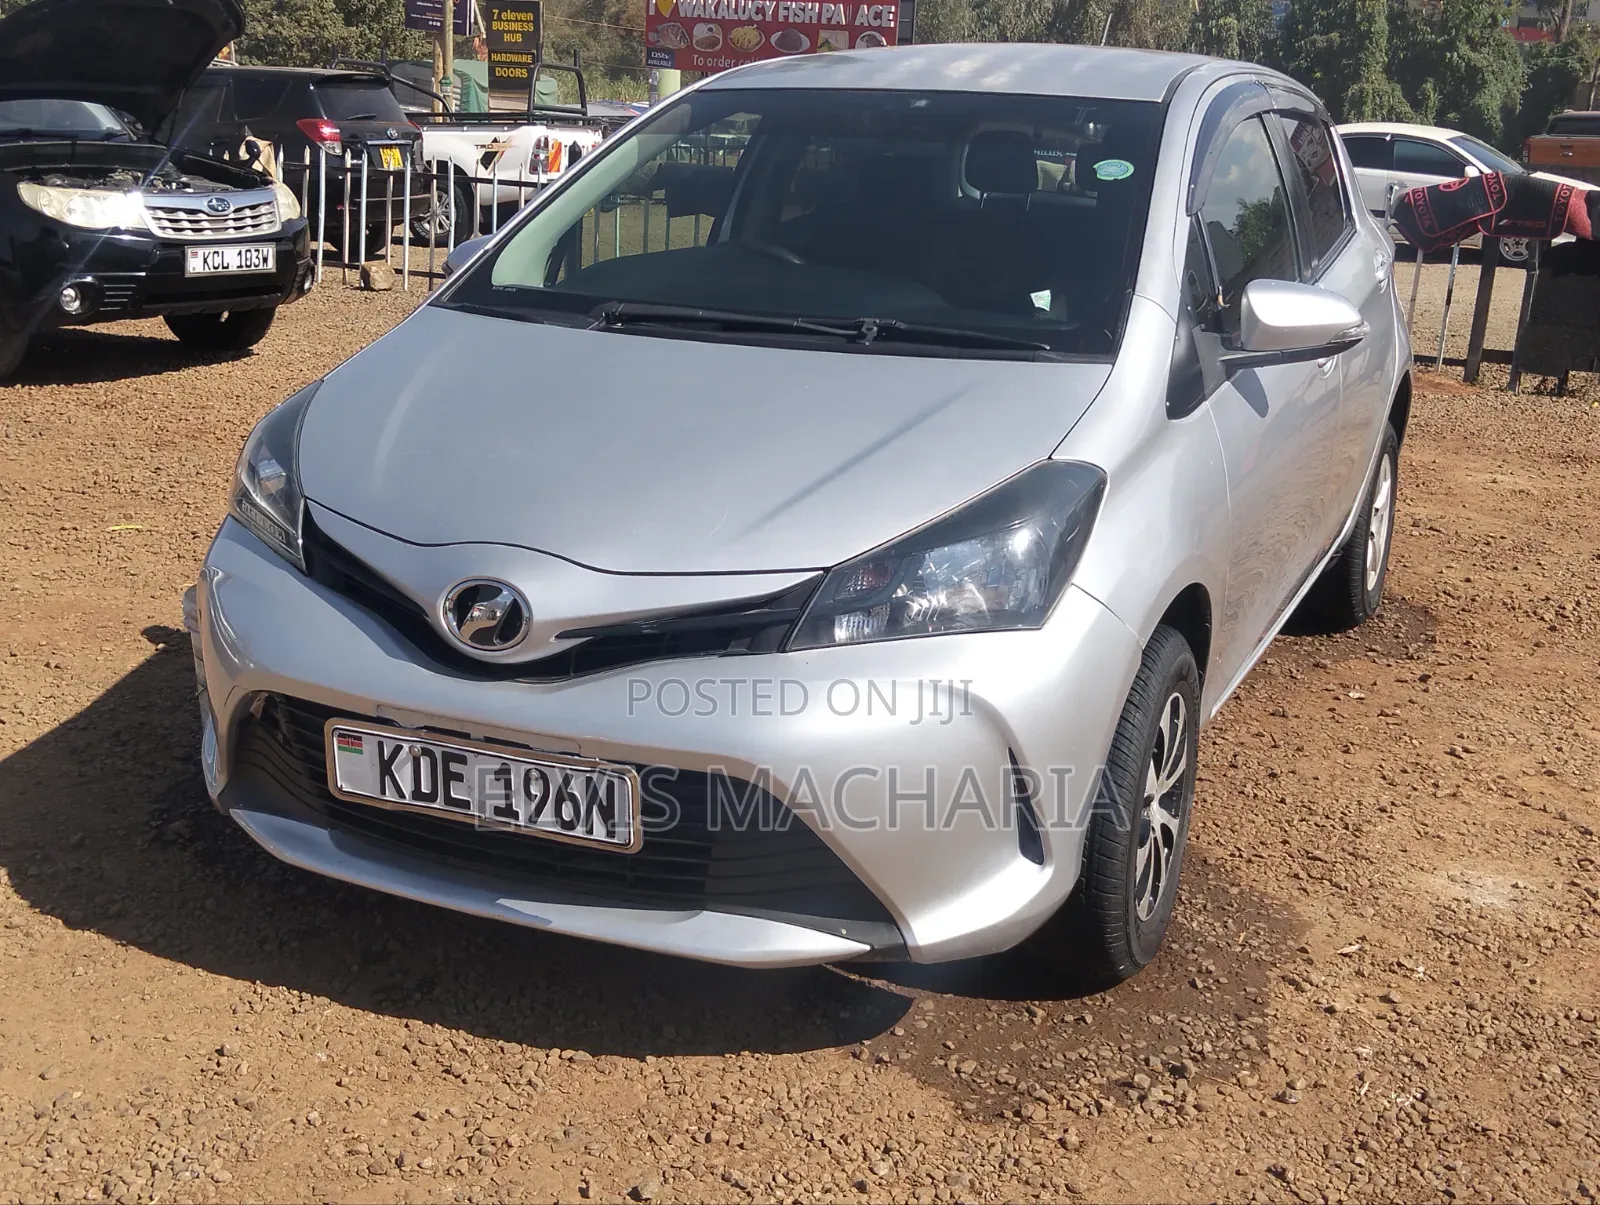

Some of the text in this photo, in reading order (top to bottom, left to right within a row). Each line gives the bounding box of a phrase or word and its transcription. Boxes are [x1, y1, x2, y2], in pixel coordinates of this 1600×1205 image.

[492, 9, 534, 21] 7 eleven
[677, 0, 777, 22] WAKALUCY
[778, 1, 819, 24] FISH
[821, 3, 895, 27] PAACE
[492, 21, 534, 31] BUSINESS
[503, 33, 523, 42] HUB
[491, 53, 533, 63] HARDWARE
[693, 54, 704, 66] To
[707, 55, 736, 68] order
[495, 67, 528, 77] DOORS
[203, 251, 230, 271] KCL
[377, 740, 617, 840] KDE 196N
